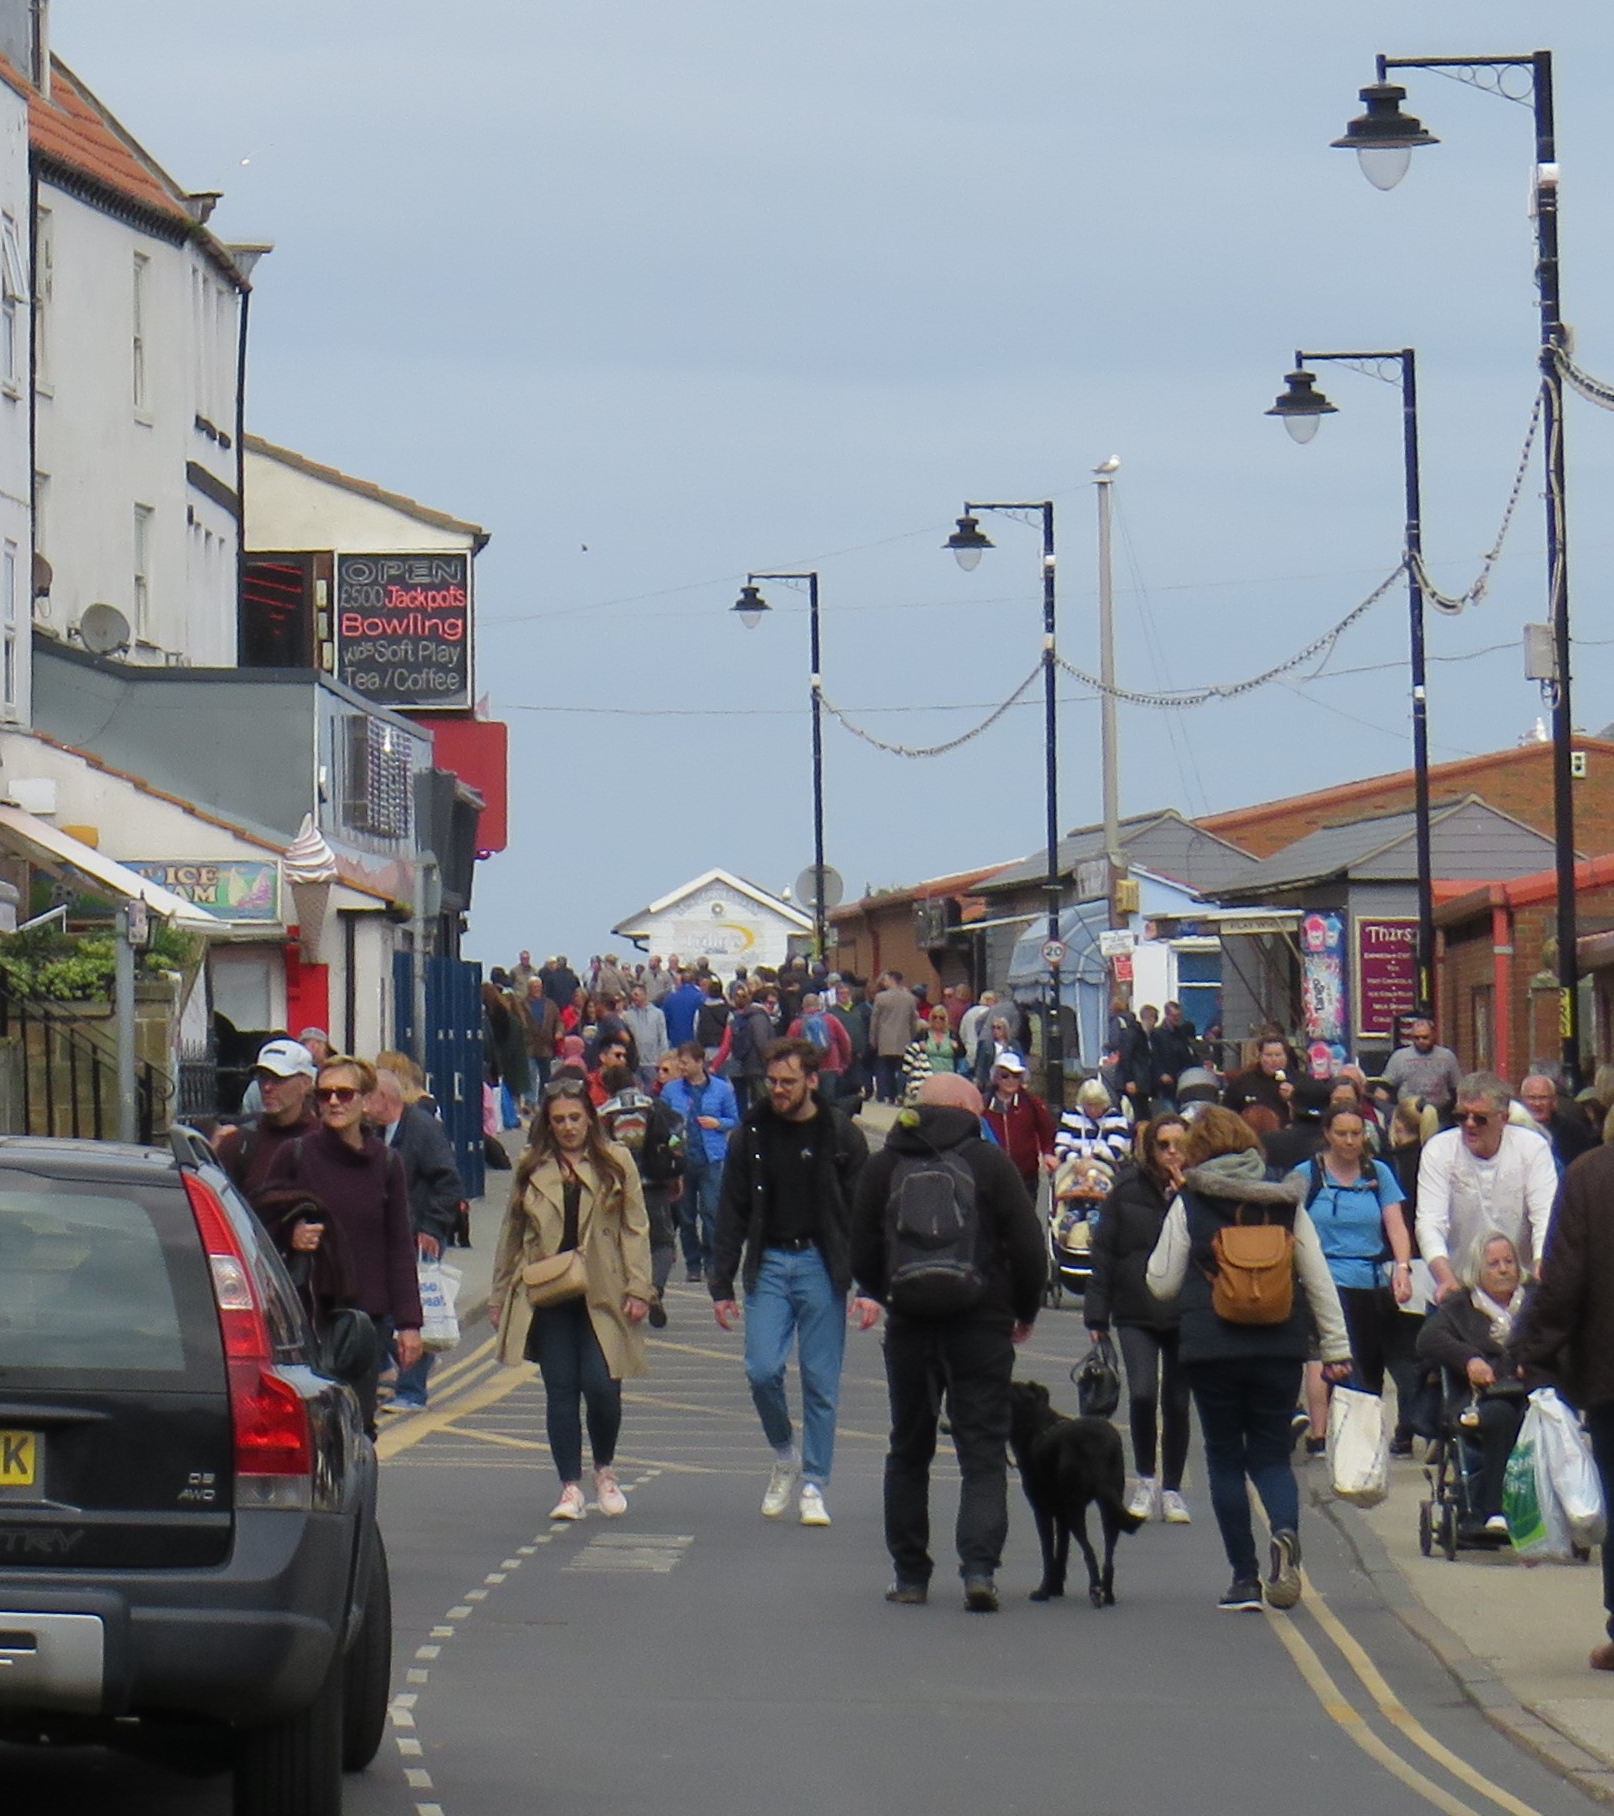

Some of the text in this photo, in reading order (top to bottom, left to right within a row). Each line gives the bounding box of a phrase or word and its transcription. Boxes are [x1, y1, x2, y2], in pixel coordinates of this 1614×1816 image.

[342, 560, 461, 584] OPEN
[341, 585, 384, 608] £500
[374, 639, 415, 663] Soft
[418, 641, 461, 667] Play
[344, 667, 379, 690] Tea
[394, 667, 460, 691] Coffee
[164, 865, 219, 884] ICE
[1045, 946, 1062, 958] 20
